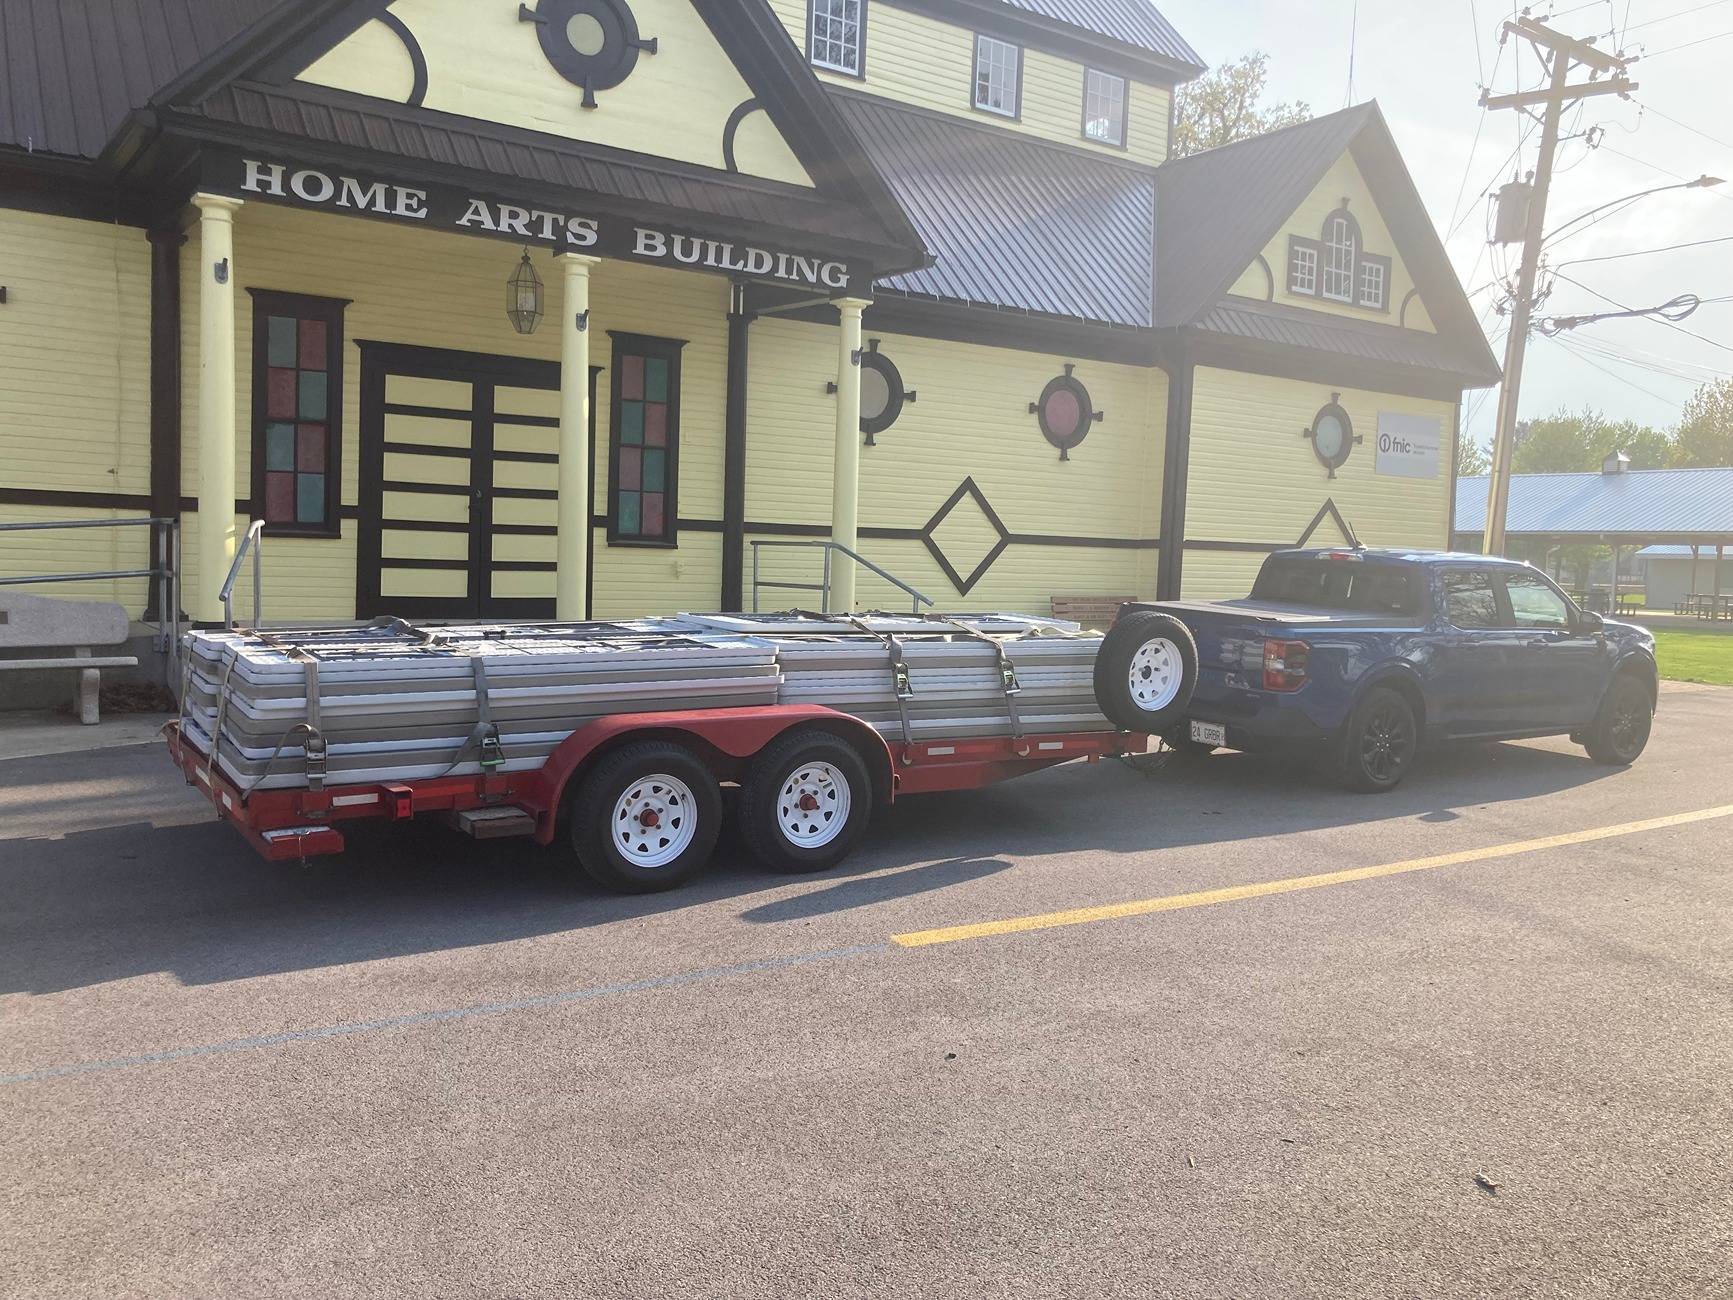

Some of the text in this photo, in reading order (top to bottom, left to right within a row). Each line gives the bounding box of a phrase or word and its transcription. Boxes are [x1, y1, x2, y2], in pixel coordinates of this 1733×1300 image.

[240, 159, 850, 288] HOME ARTS BUILDING
